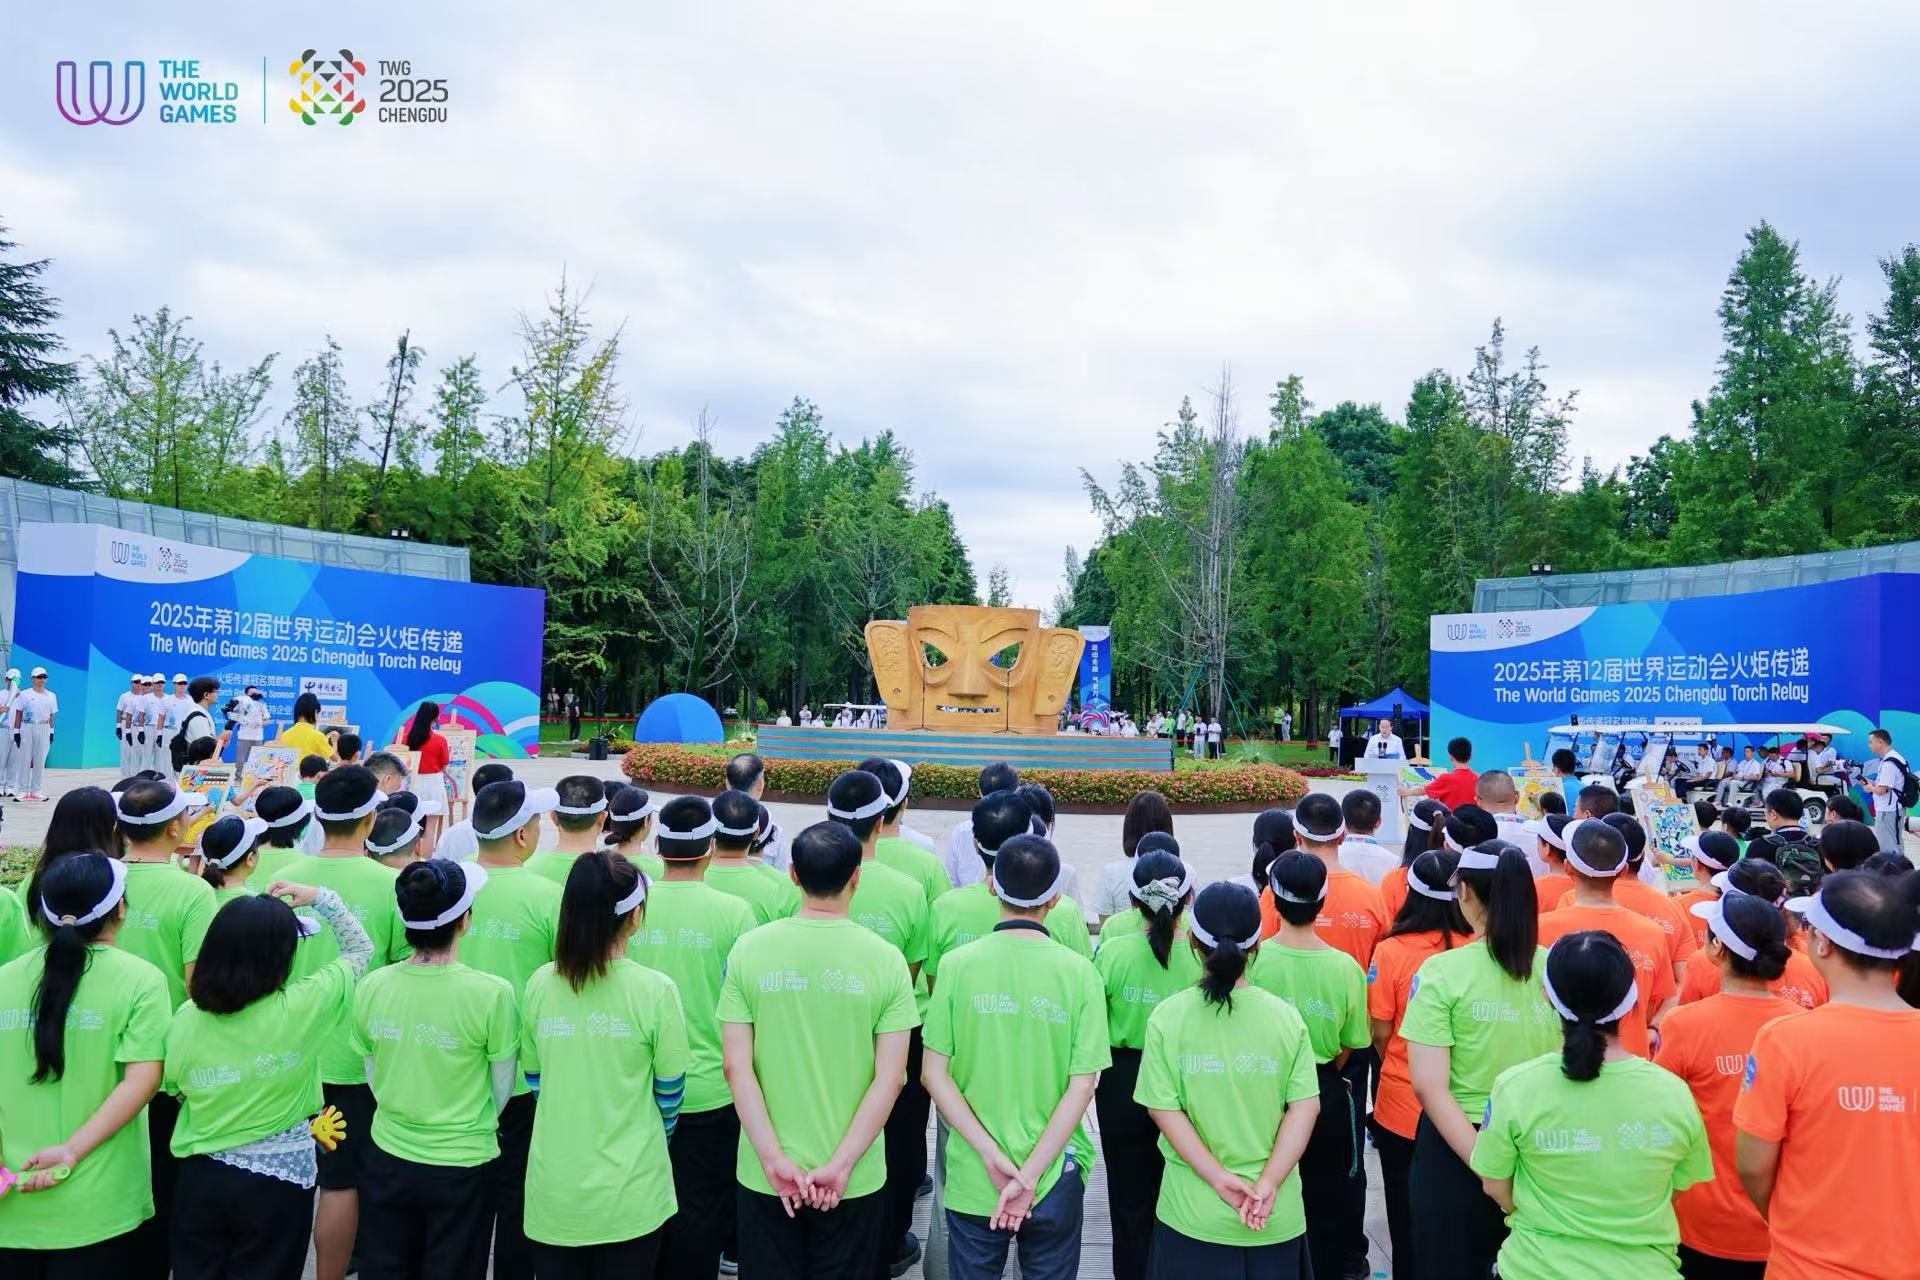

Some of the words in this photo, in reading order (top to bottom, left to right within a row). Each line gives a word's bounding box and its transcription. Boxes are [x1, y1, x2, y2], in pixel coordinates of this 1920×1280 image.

[150, 601, 463, 653] 2025年第12届世界运动会火炬传递
[150, 633, 174, 653] The
[177, 636, 217, 657] World
[220, 640, 268, 660] Games
[272, 645, 308, 663] 2025
[311, 647, 374, 669] Chengdu
[378, 652, 417, 669] Torch
[421, 655, 462, 675] Relay
[1493, 646, 1810, 684] 2025年第12届世界运动会火炬传递
[1493, 687, 1520, 703] The
[1524, 687, 1567, 703] World
[1570, 687, 1620, 703] Games
[1624, 686, 1661, 703] 2025
[1665, 683, 1727, 705] Chengdu
[1730, 682, 1767, 702] Torch
[1771, 681, 1809, 704] Relay
